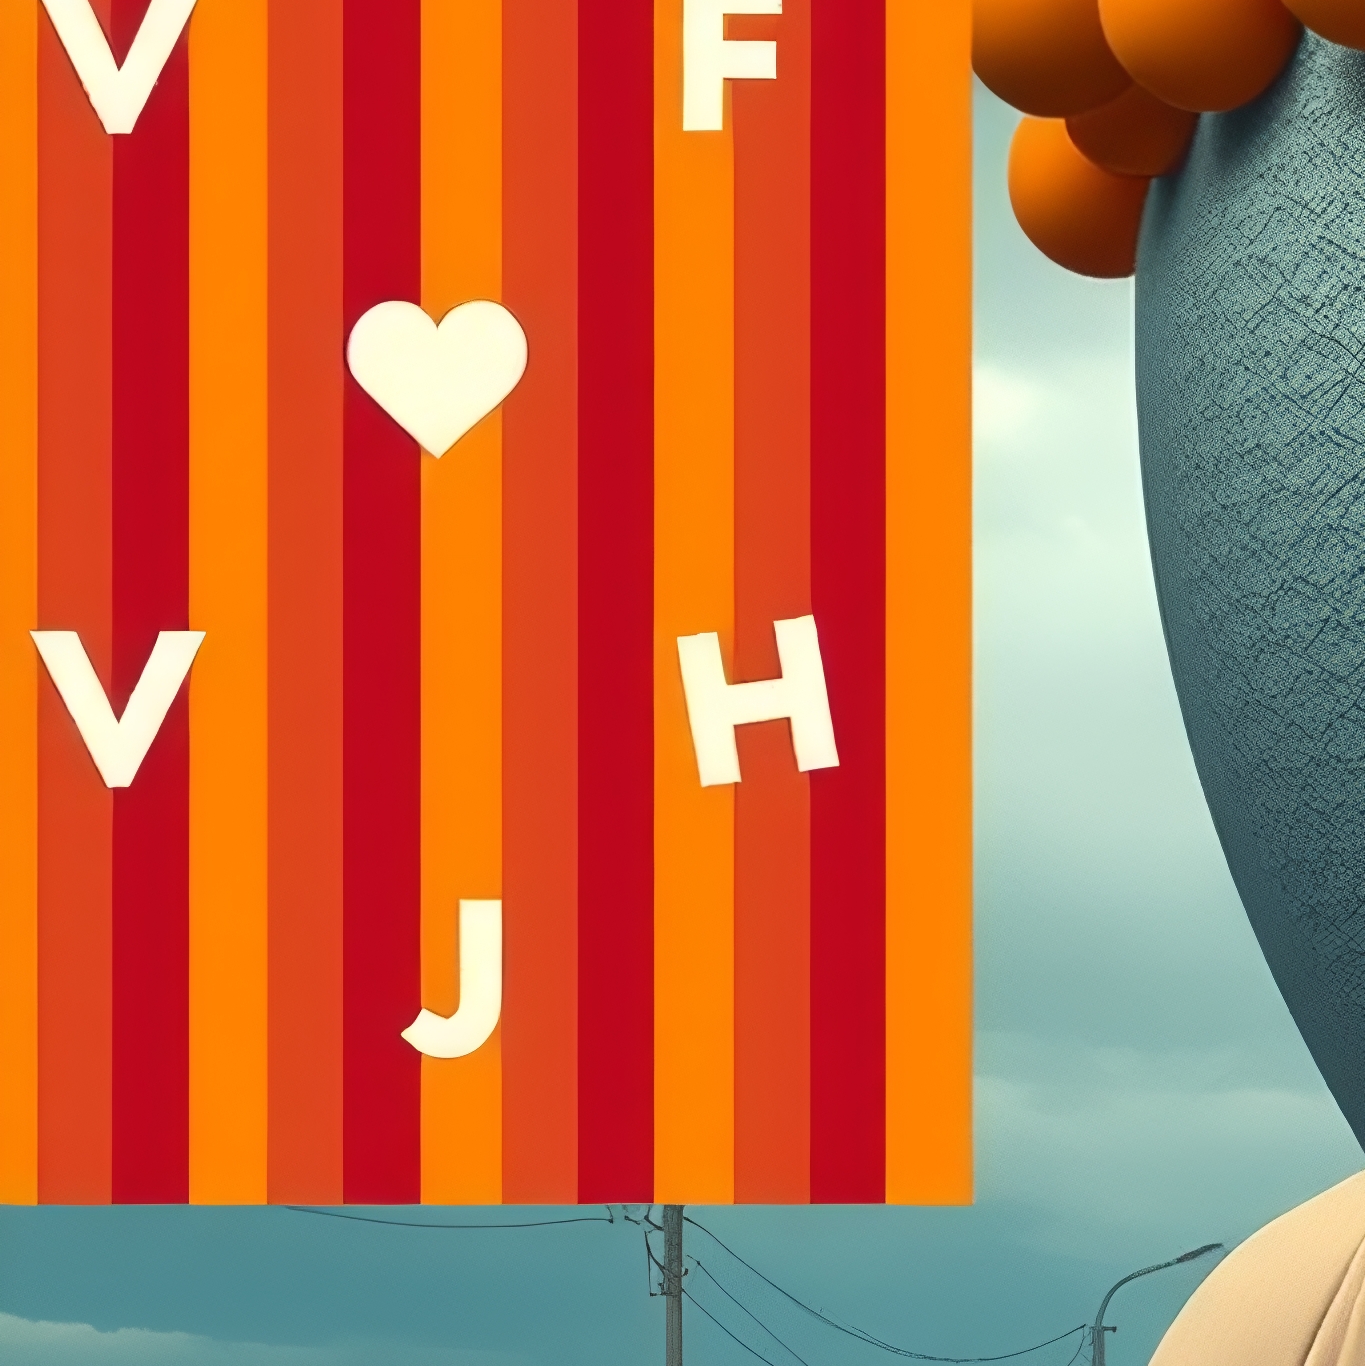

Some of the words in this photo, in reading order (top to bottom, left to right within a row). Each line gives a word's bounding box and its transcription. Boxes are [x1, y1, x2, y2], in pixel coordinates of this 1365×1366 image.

[31, 631, 206, 788] V
[678, 615, 839, 786] H
[401, 901, 502, 1058] J
